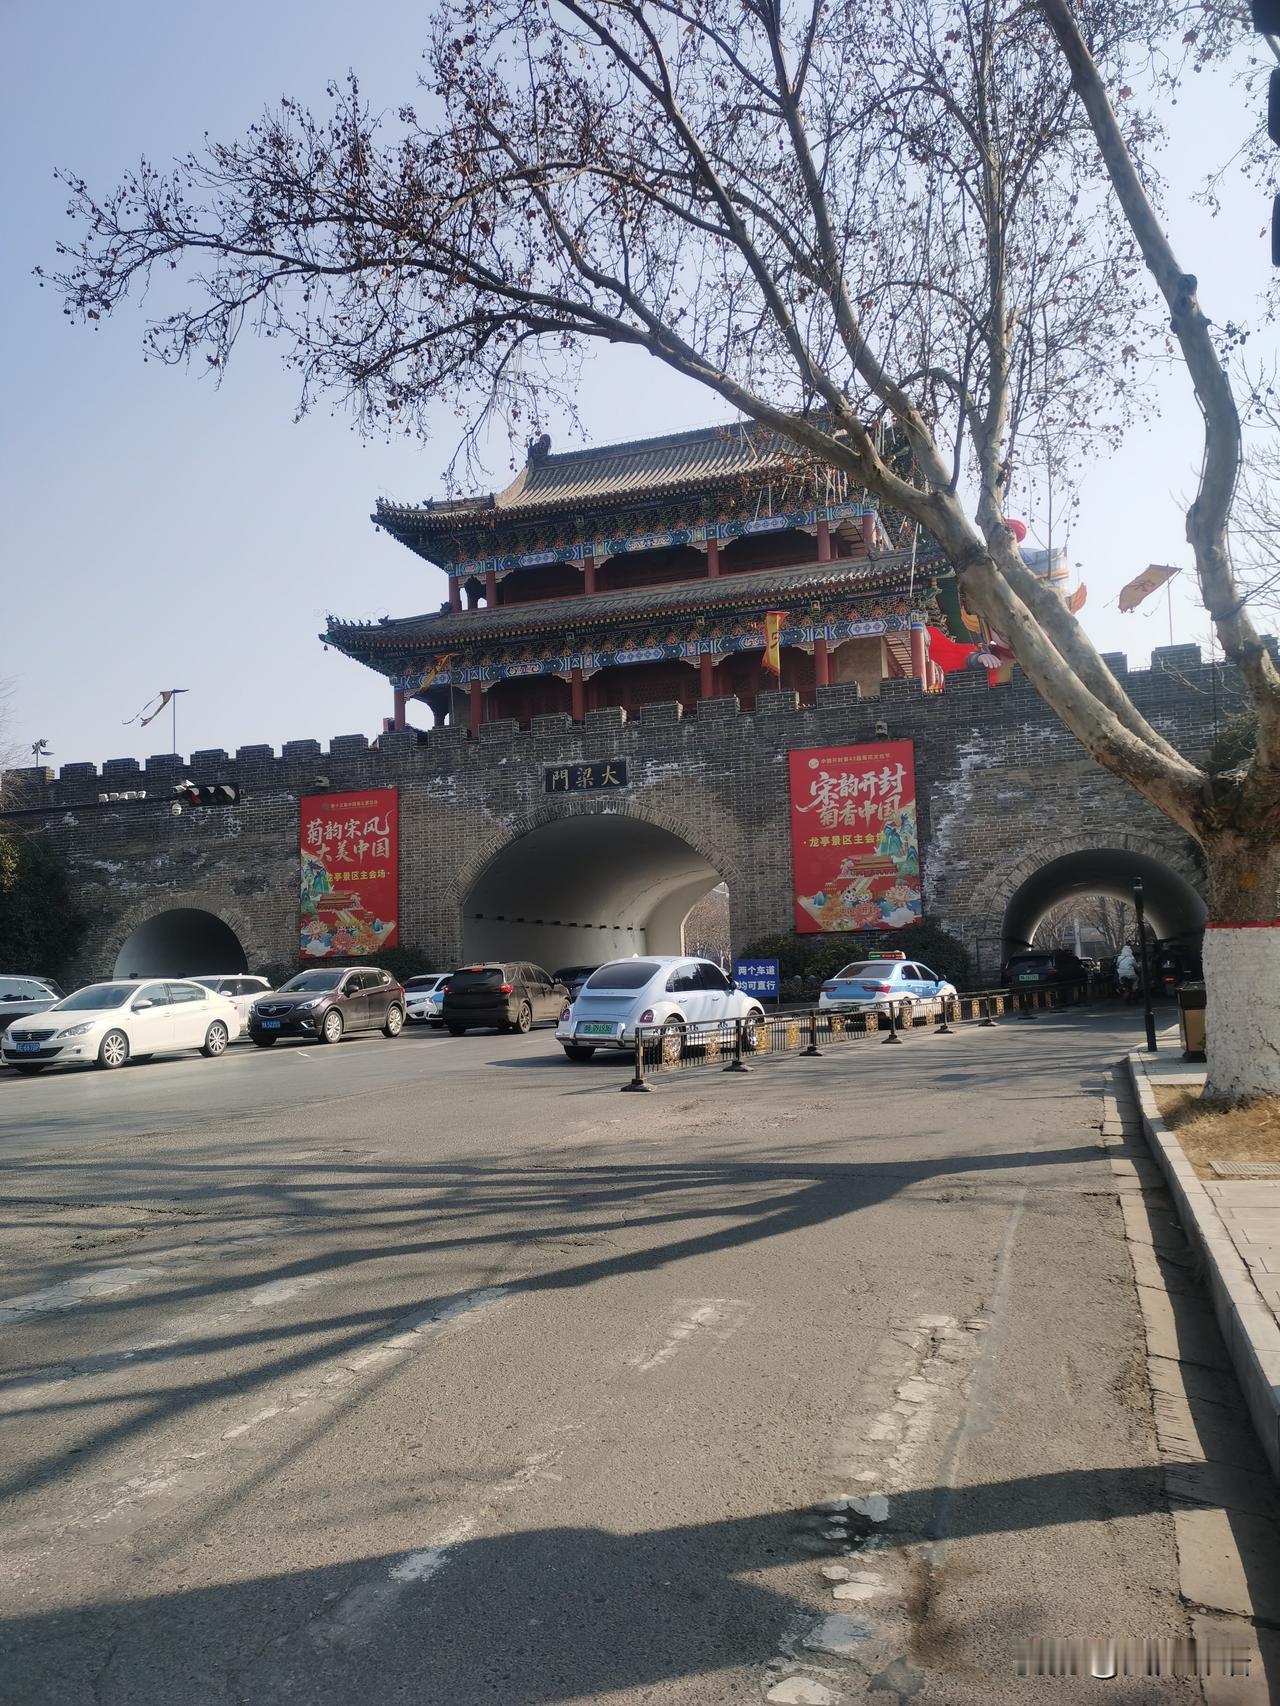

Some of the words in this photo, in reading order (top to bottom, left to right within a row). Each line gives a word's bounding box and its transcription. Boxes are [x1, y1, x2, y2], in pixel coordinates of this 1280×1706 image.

[797, 763, 907, 811] 宋韵开封
[816, 795, 901, 830] 菊香中国
[306, 811, 392, 845] 菊韵宋风
[809, 832, 886, 847] 龙亭景区主会场
[315, 838, 390, 863] 大美中国
[326, 869, 385, 882] 龙亭景区主会场
[738, 965, 775, 976] 两个车道
[737, 980, 776, 990] 均可直行
